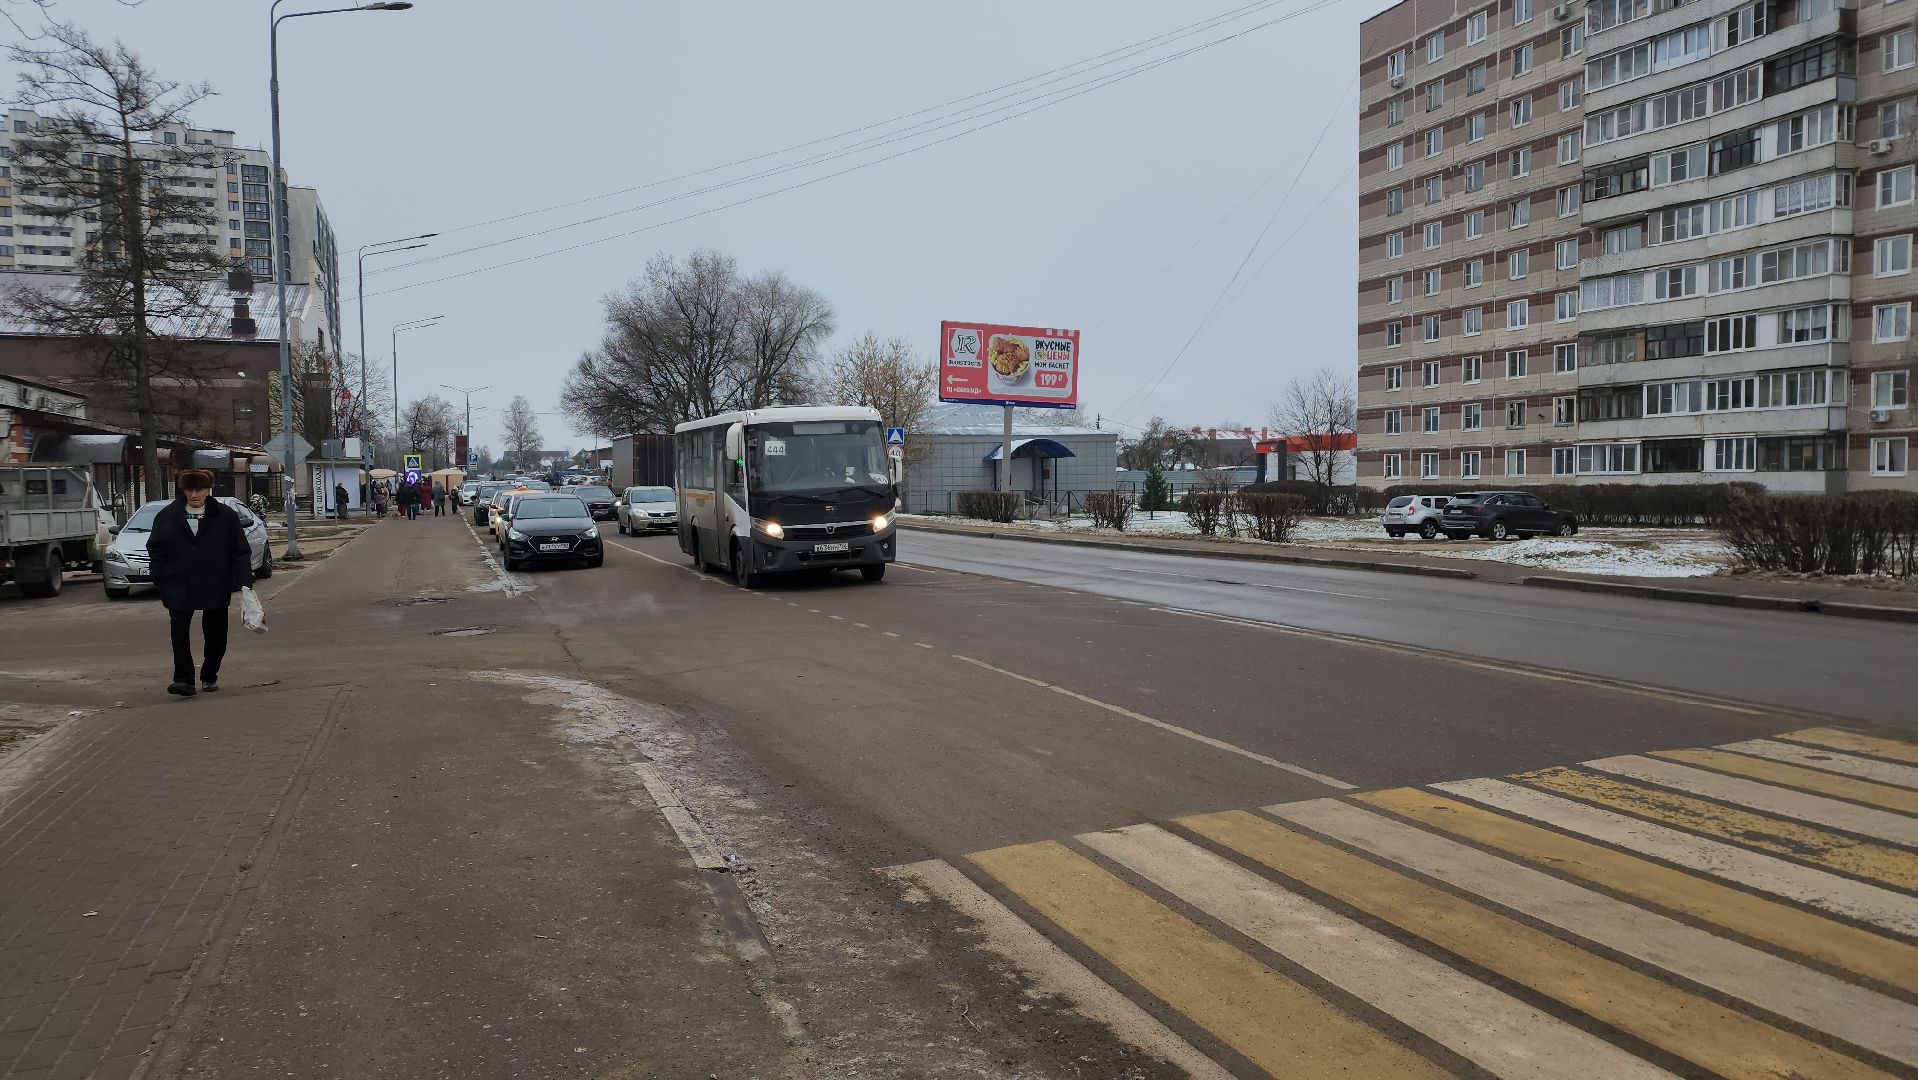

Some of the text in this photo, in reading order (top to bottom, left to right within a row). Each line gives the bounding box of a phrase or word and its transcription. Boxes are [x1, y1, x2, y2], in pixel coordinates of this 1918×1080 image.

[1035, 340, 1071, 352] ВКУСНЫЕ
[1047, 351, 1069, 360] ЦЕНЫ
[767, 445, 784, 454] 444
